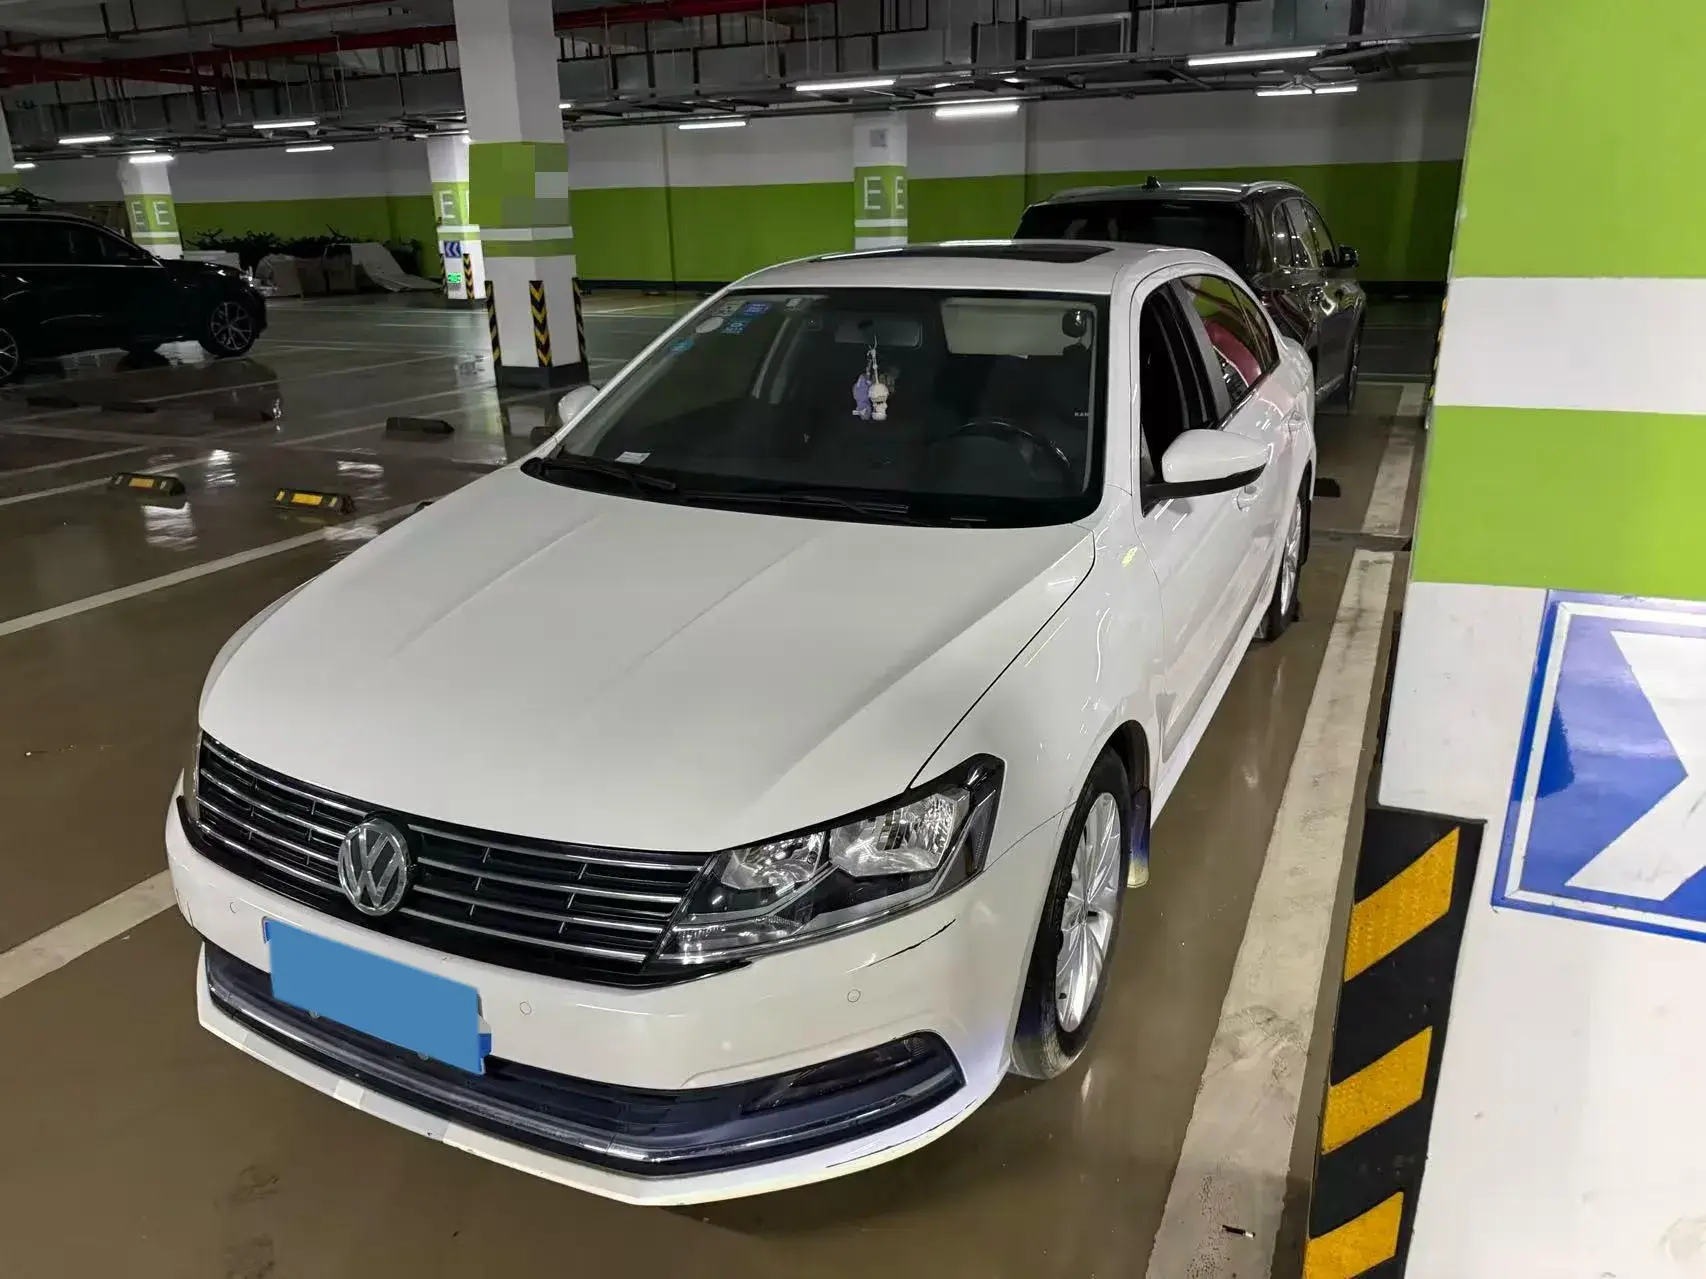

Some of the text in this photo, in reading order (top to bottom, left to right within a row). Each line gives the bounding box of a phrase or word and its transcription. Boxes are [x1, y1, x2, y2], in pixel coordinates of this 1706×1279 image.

[440, 190, 456, 219] E
[864, 176, 881, 210] E
[132, 201, 145, 225] E
[153, 201, 170, 226] E
[340, 821, 406, 914] VW
